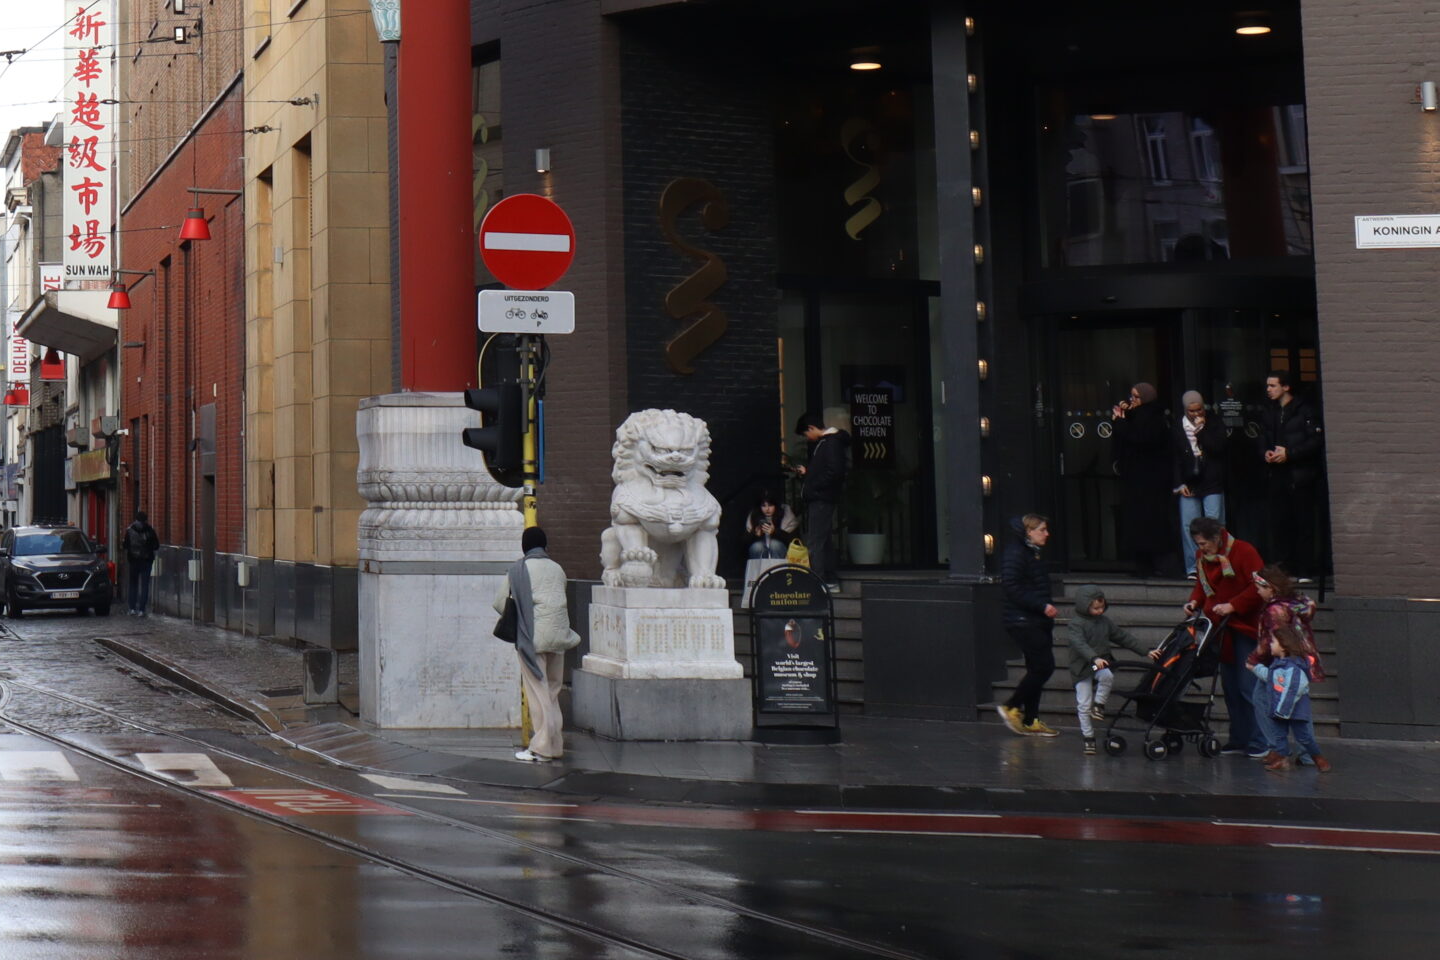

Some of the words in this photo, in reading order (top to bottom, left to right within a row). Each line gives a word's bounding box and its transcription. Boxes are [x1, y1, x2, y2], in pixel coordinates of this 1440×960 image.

[67, 6, 107, 259] 新華超級市場
[1373, 226, 1432, 236] KONINGIN
[65, 265, 86, 276] SUN
[87, 265, 109, 276] WAH
[504, 295, 549, 303] UITGEZONDERD
[855, 393, 888, 404] WELCOME
[868, 405, 877, 415] TO
[853, 416, 892, 426] CHOCOLATE
[860, 427, 887, 437] HEAVEN
[769, 591, 811, 599] chocolate
